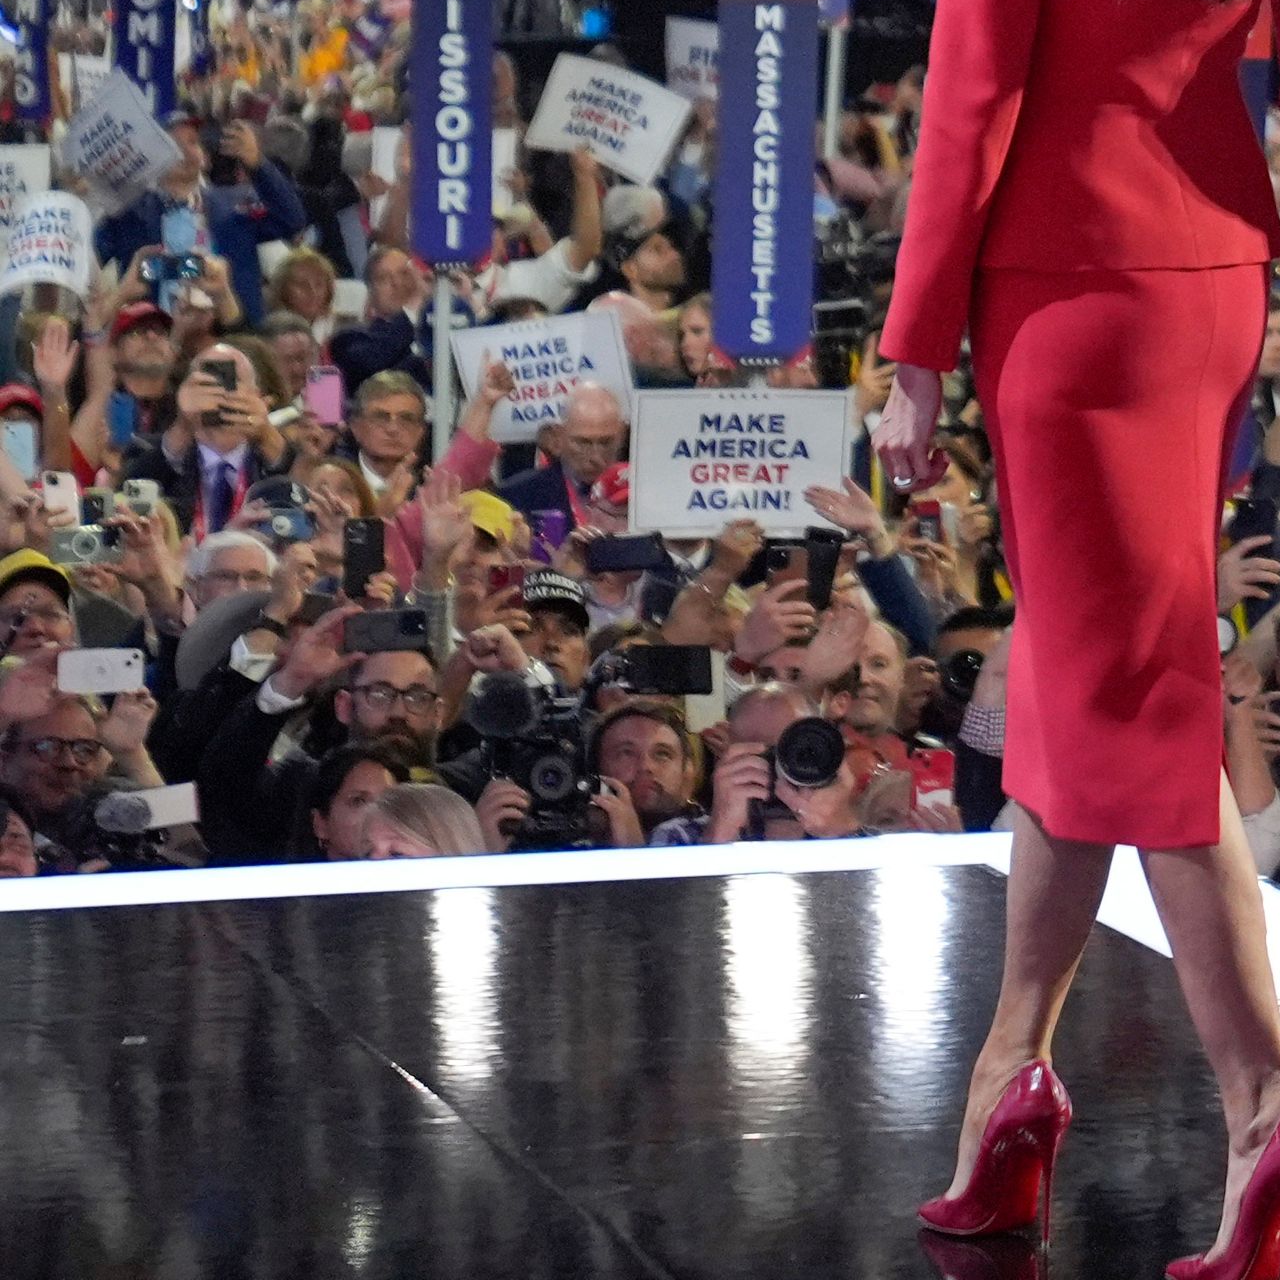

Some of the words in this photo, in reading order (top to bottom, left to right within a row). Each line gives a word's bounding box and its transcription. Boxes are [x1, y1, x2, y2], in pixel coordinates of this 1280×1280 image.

[590, 76, 642, 108] MAKE
[565, 88, 648, 131] AMERICA
[749, 3, 786, 345] MASSACHUSETTS
[501, 336, 568, 362] MAKE
[509, 353, 595, 382] MERICA
[699, 412, 786, 435] MAKE
[670, 437, 811, 460] AMERICA
[689, 462, 791, 485] GREAT
[687, 488, 792, 512] AGAIN!
